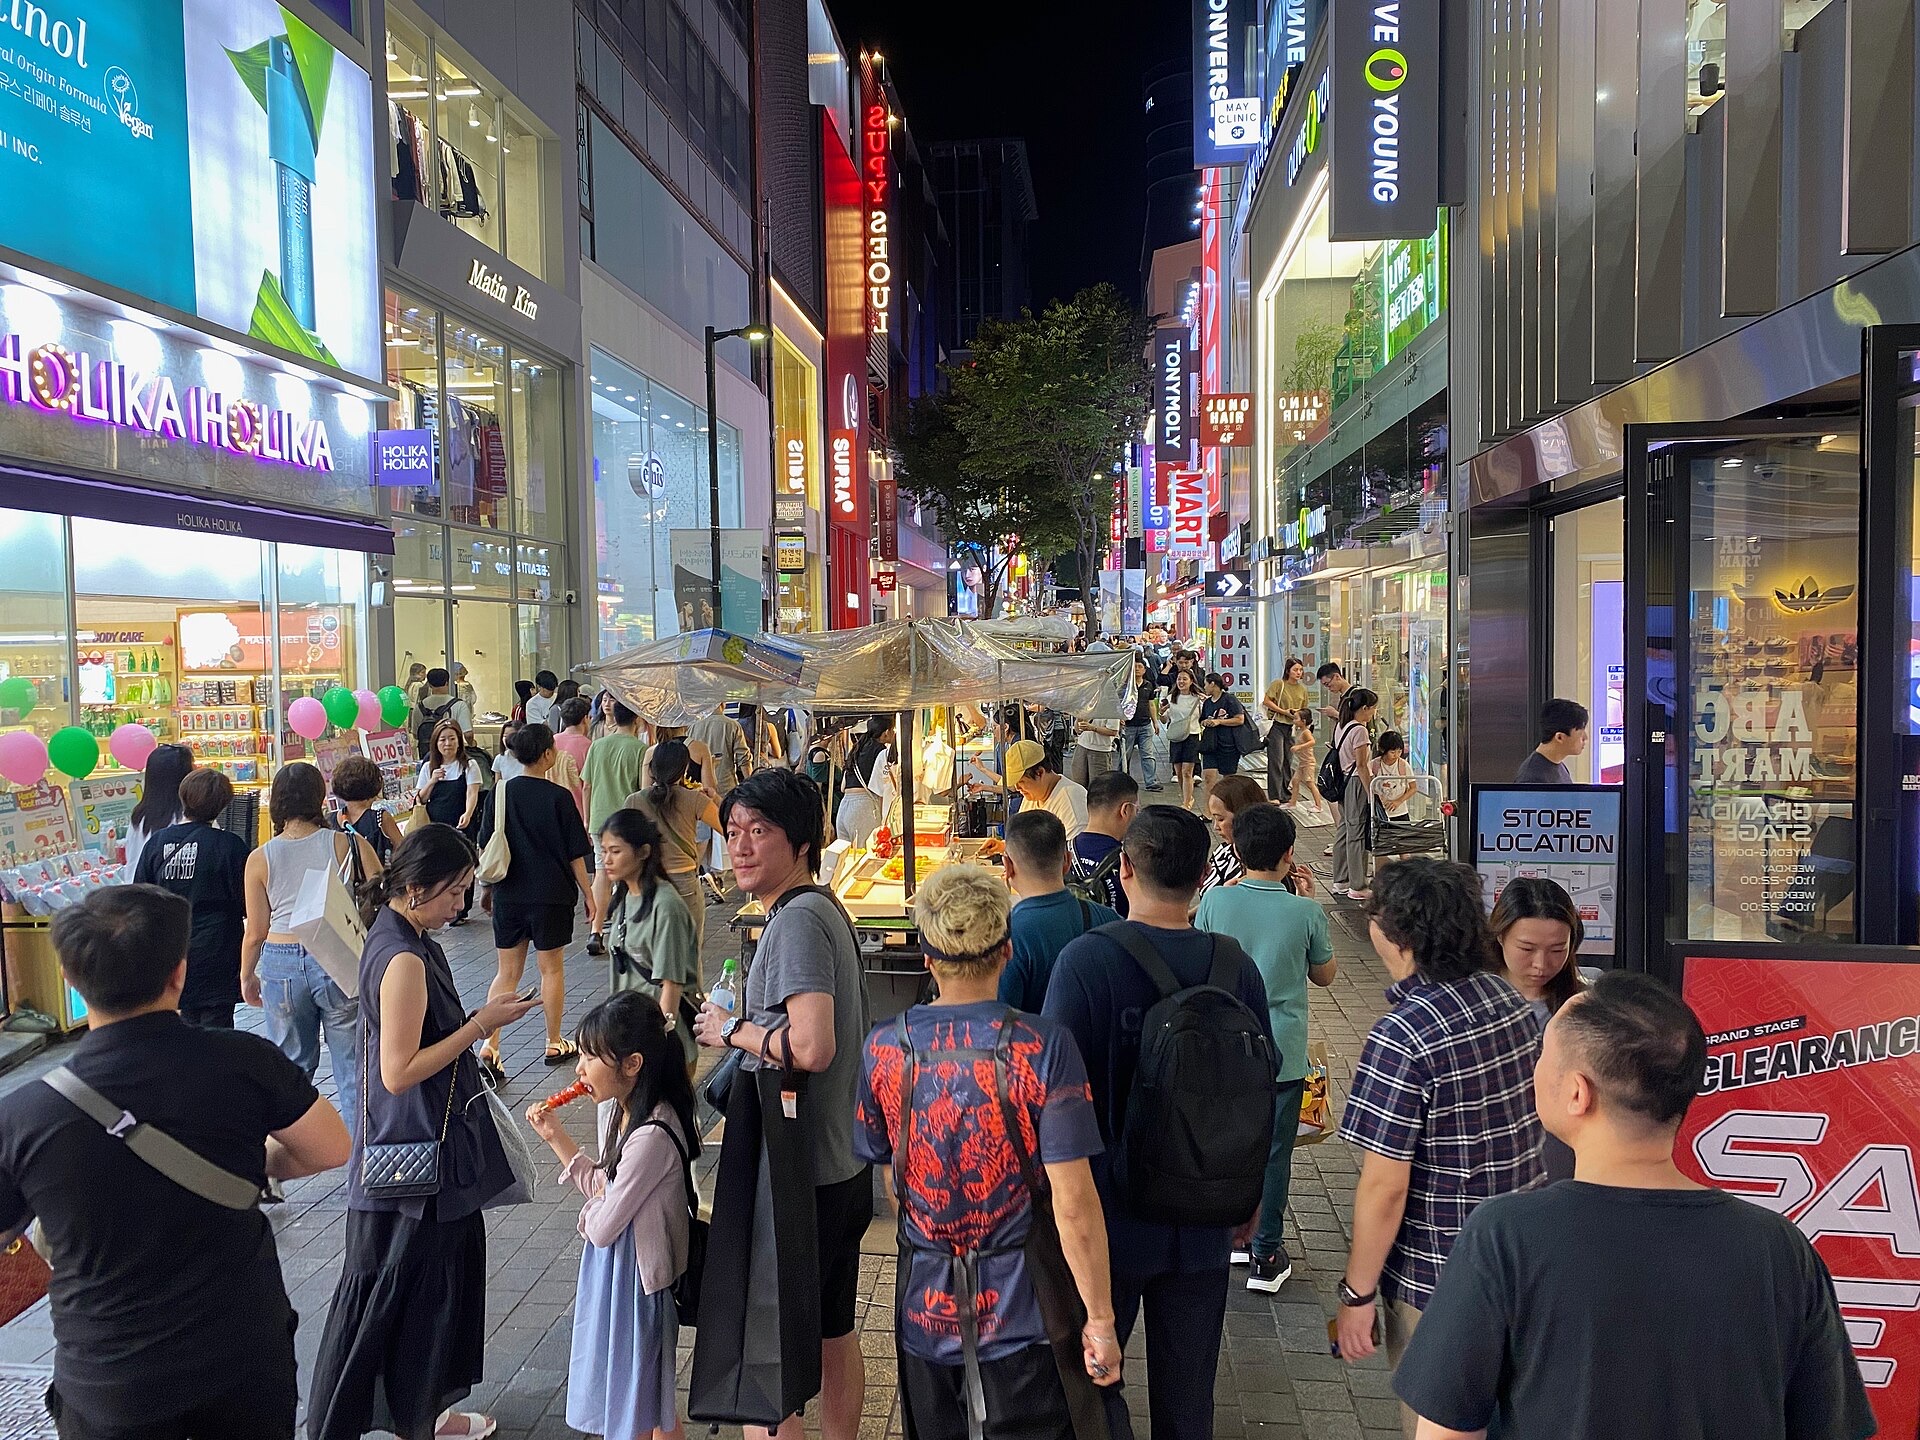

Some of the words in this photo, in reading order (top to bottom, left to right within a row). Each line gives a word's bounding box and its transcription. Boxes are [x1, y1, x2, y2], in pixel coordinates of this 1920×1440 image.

[17, 54, 56, 87] Origin
[58, 76, 108, 115] Formula
[23, 83, 57, 117] 리페어
[59, 104, 92, 134] 솔루션
[117, 102, 154, 140] Vegan
[1218, 113, 1257, 124] CLINIC
[1226, 102, 1249, 112] MAY
[1232, 128, 1244, 137] 3F
[12, 136, 43, 165] INC.
[1373, 94, 1399, 201] YOUNG
[1389, 244, 1411, 294] LIVE
[468, 259, 507, 303] Matin
[512, 285, 538, 320] Kim
[1389, 273, 1425, 333] BETTER
[1165, 340, 1181, 449] TONYMOLY
[1206, 399, 1250, 412] JUNO
[187, 386, 336, 472] HOLIKA
[1210, 411, 1245, 424] HAIR
[382, 445, 428, 458] HOLIKA
[1219, 432, 1235, 443] 4F
[383, 457, 429, 471] HOLIKA
[833, 437, 851, 503] SUPRA
[1131, 469, 1139, 501] NATURE
[177, 513, 211, 529] HOLIKA
[212, 518, 243, 533] HOLIKA
[1131, 501, 1139, 536] REPUBLIC
[1175, 473, 1204, 547] MART
[1721, 536, 1762, 554] ABC
[1720, 555, 1762, 568] MART
[119, 631, 145, 643] CARE
[1221, 616, 1234, 687] JUNO
[1238, 616, 1251, 687] HAIR
[1502, 809, 1592, 829] STORE
[1480, 833, 1614, 854] LOCATION
[1705, 1029, 1749, 1046] GRAND
[1754, 1018, 1800, 1036] STAGE
[1697, 1016, 1920, 1096] CLEARANC
